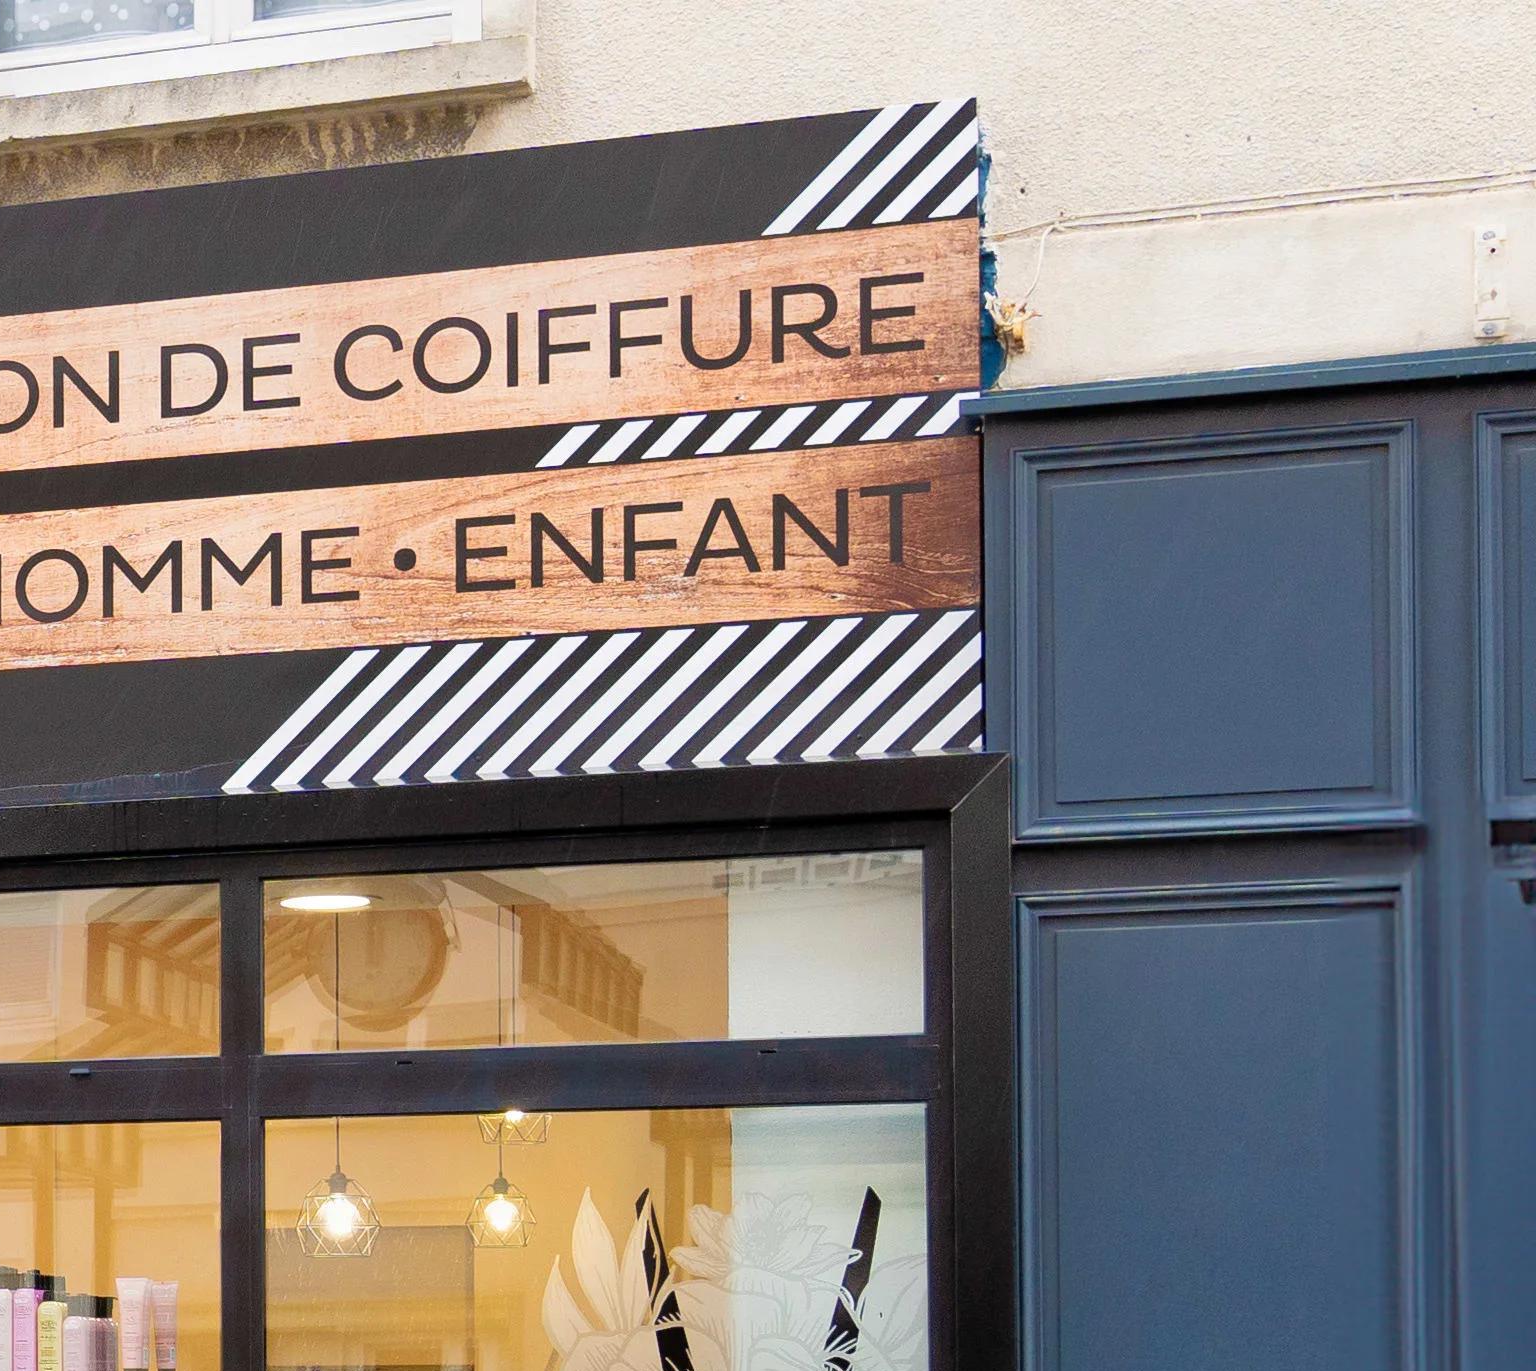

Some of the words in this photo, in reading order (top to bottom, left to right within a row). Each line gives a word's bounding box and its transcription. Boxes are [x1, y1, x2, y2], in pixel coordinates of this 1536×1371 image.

[160, 332, 302, 419] DE
[334, 272, 926, 401] COIFFURE
[455, 481, 932, 593] ENFANT
